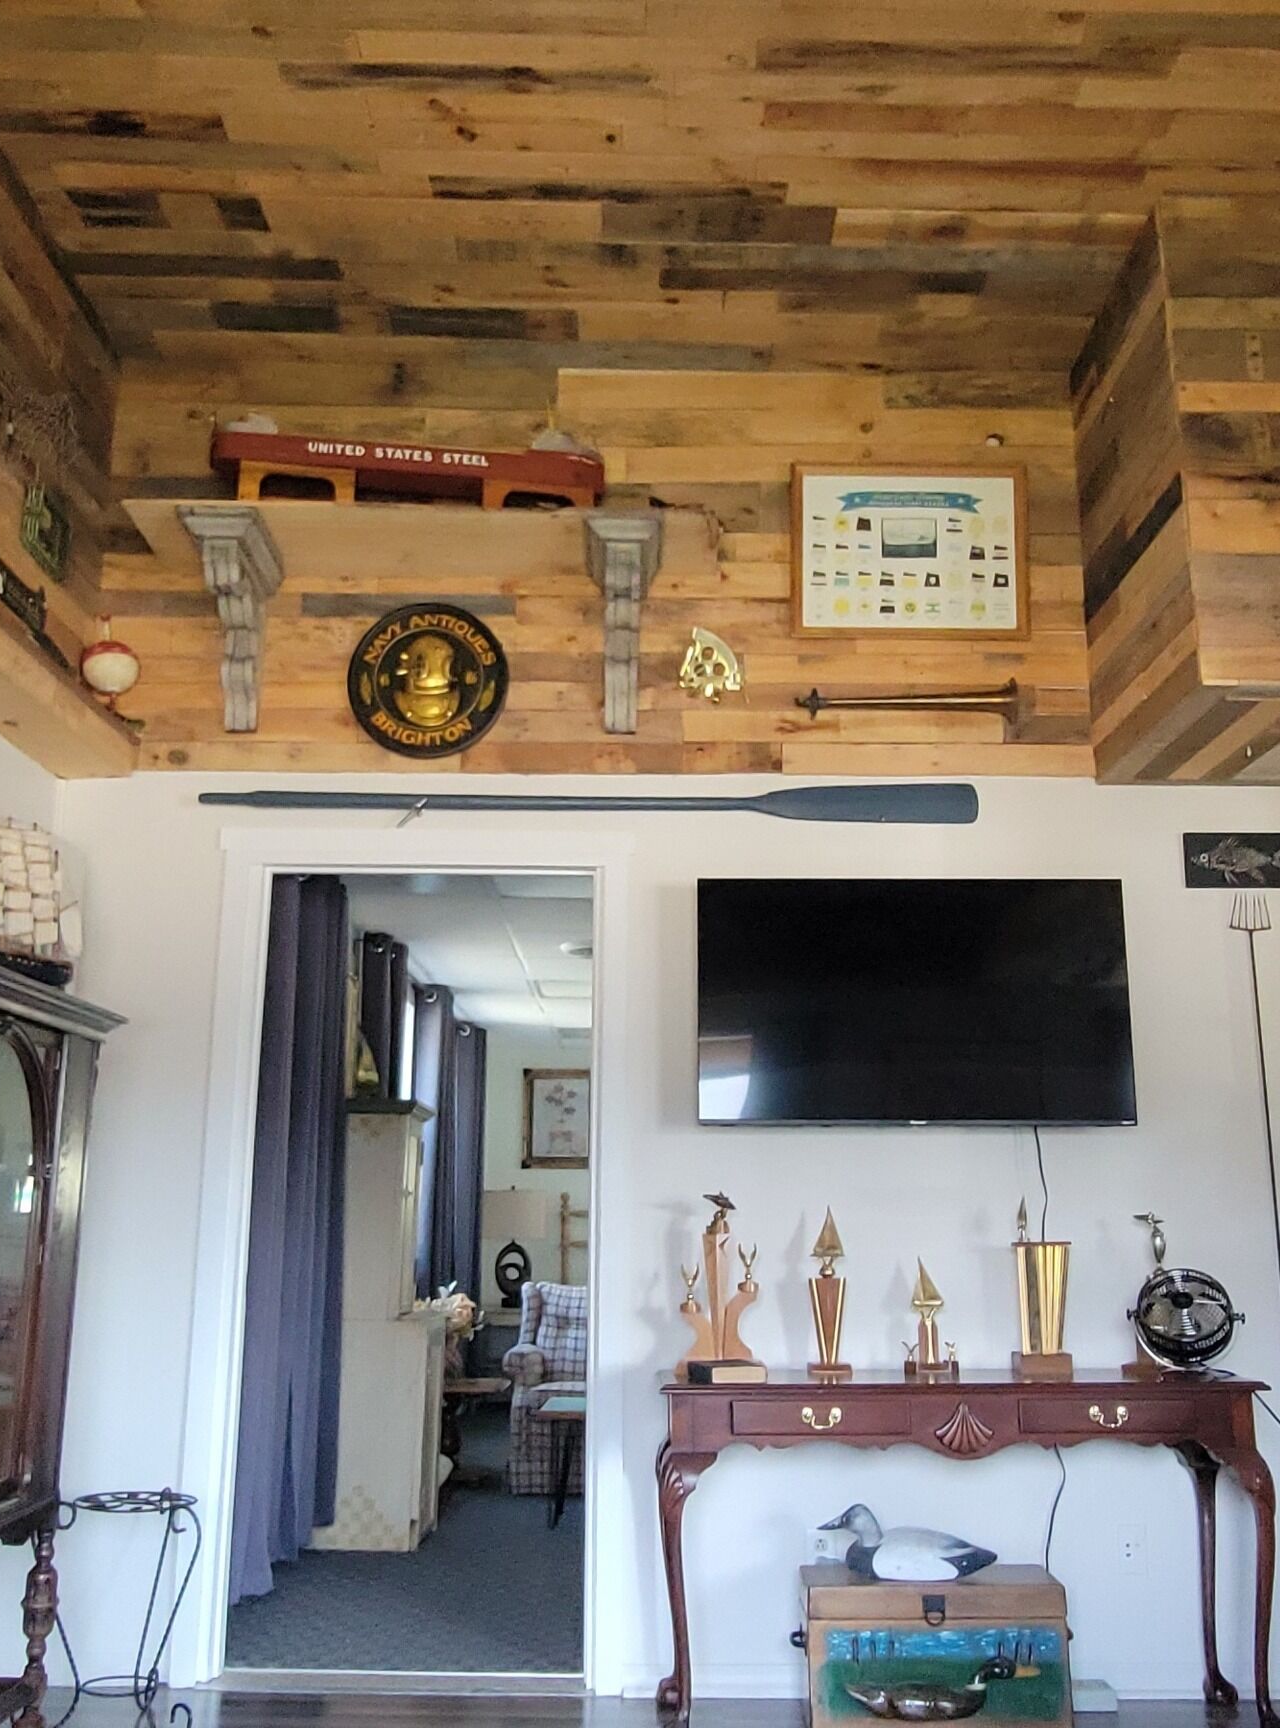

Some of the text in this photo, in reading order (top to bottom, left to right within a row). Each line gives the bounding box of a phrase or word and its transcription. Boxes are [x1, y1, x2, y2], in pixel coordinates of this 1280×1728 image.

[308, 441, 489, 467] UNITED STATES STEEL
[409, 614, 497, 666] ANTIQUES
[371, 711, 472, 746] BRIGHTON
